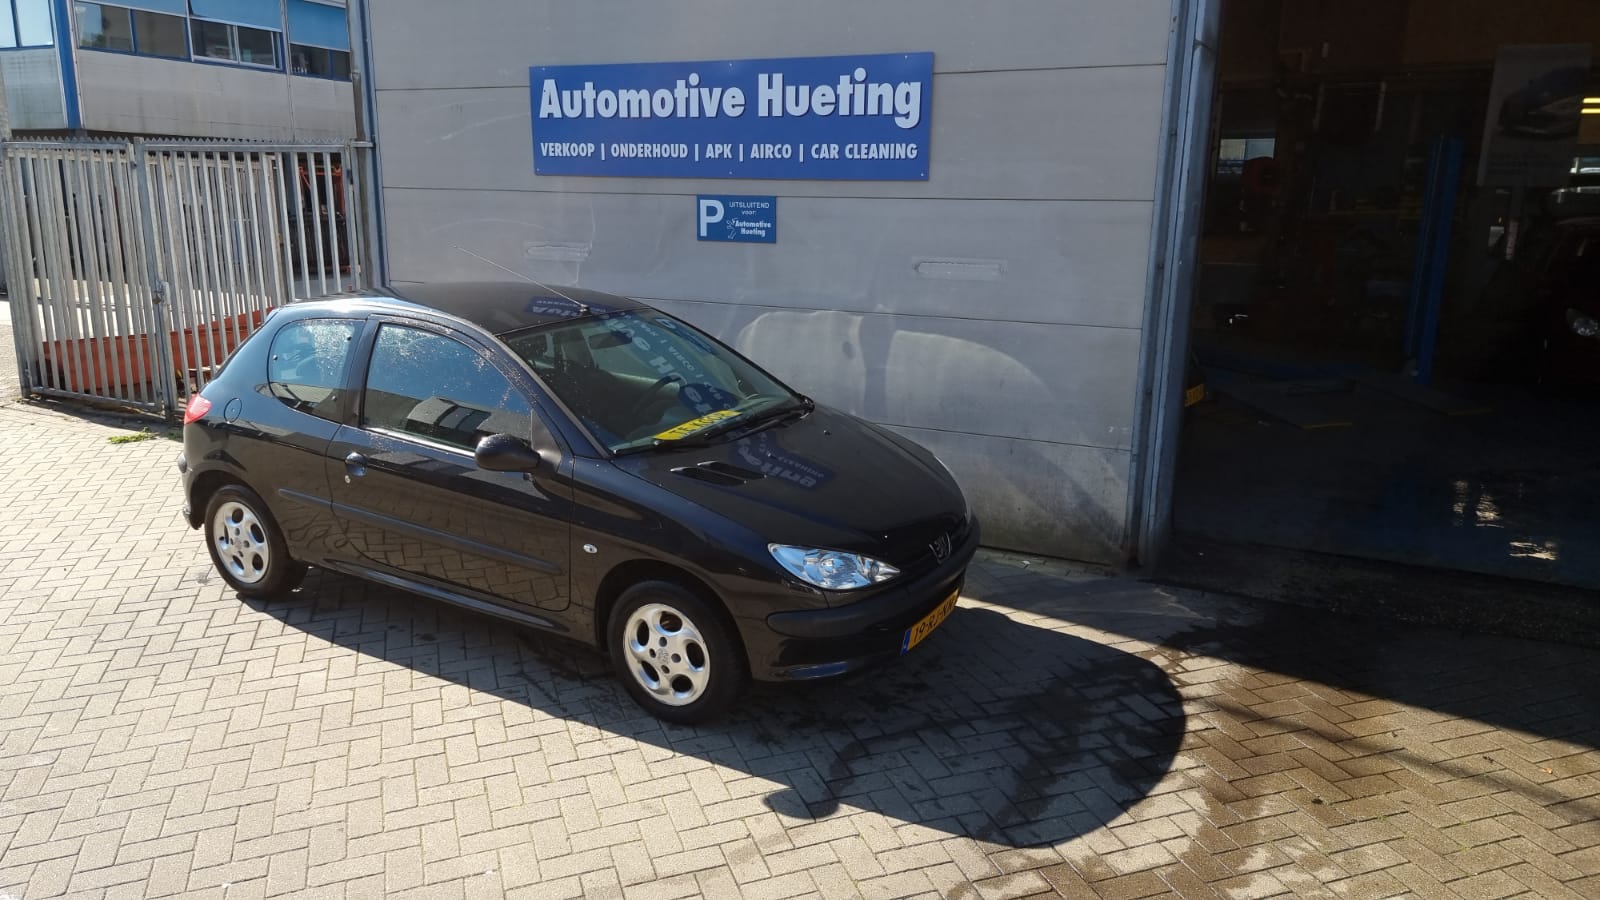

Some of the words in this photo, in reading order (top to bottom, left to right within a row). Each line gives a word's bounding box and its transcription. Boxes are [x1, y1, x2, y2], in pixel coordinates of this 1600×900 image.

[539, 72, 745, 118] Automotive
[758, 67, 921, 129] Hueting
[540, 142, 595, 157] VERKOOP
[610, 143, 689, 158] ONDERHOUD
[705, 143, 732, 159] APK
[750, 143, 792, 159] AIRCO
[811, 143, 840, 159] CAR
[844, 143, 918, 159] CLEANING
[729, 201, 770, 209] UITSLUITEND
[699, 199, 725, 237] P
[735, 220, 772, 229] Automotive
[740, 227, 766, 238] Hueting
